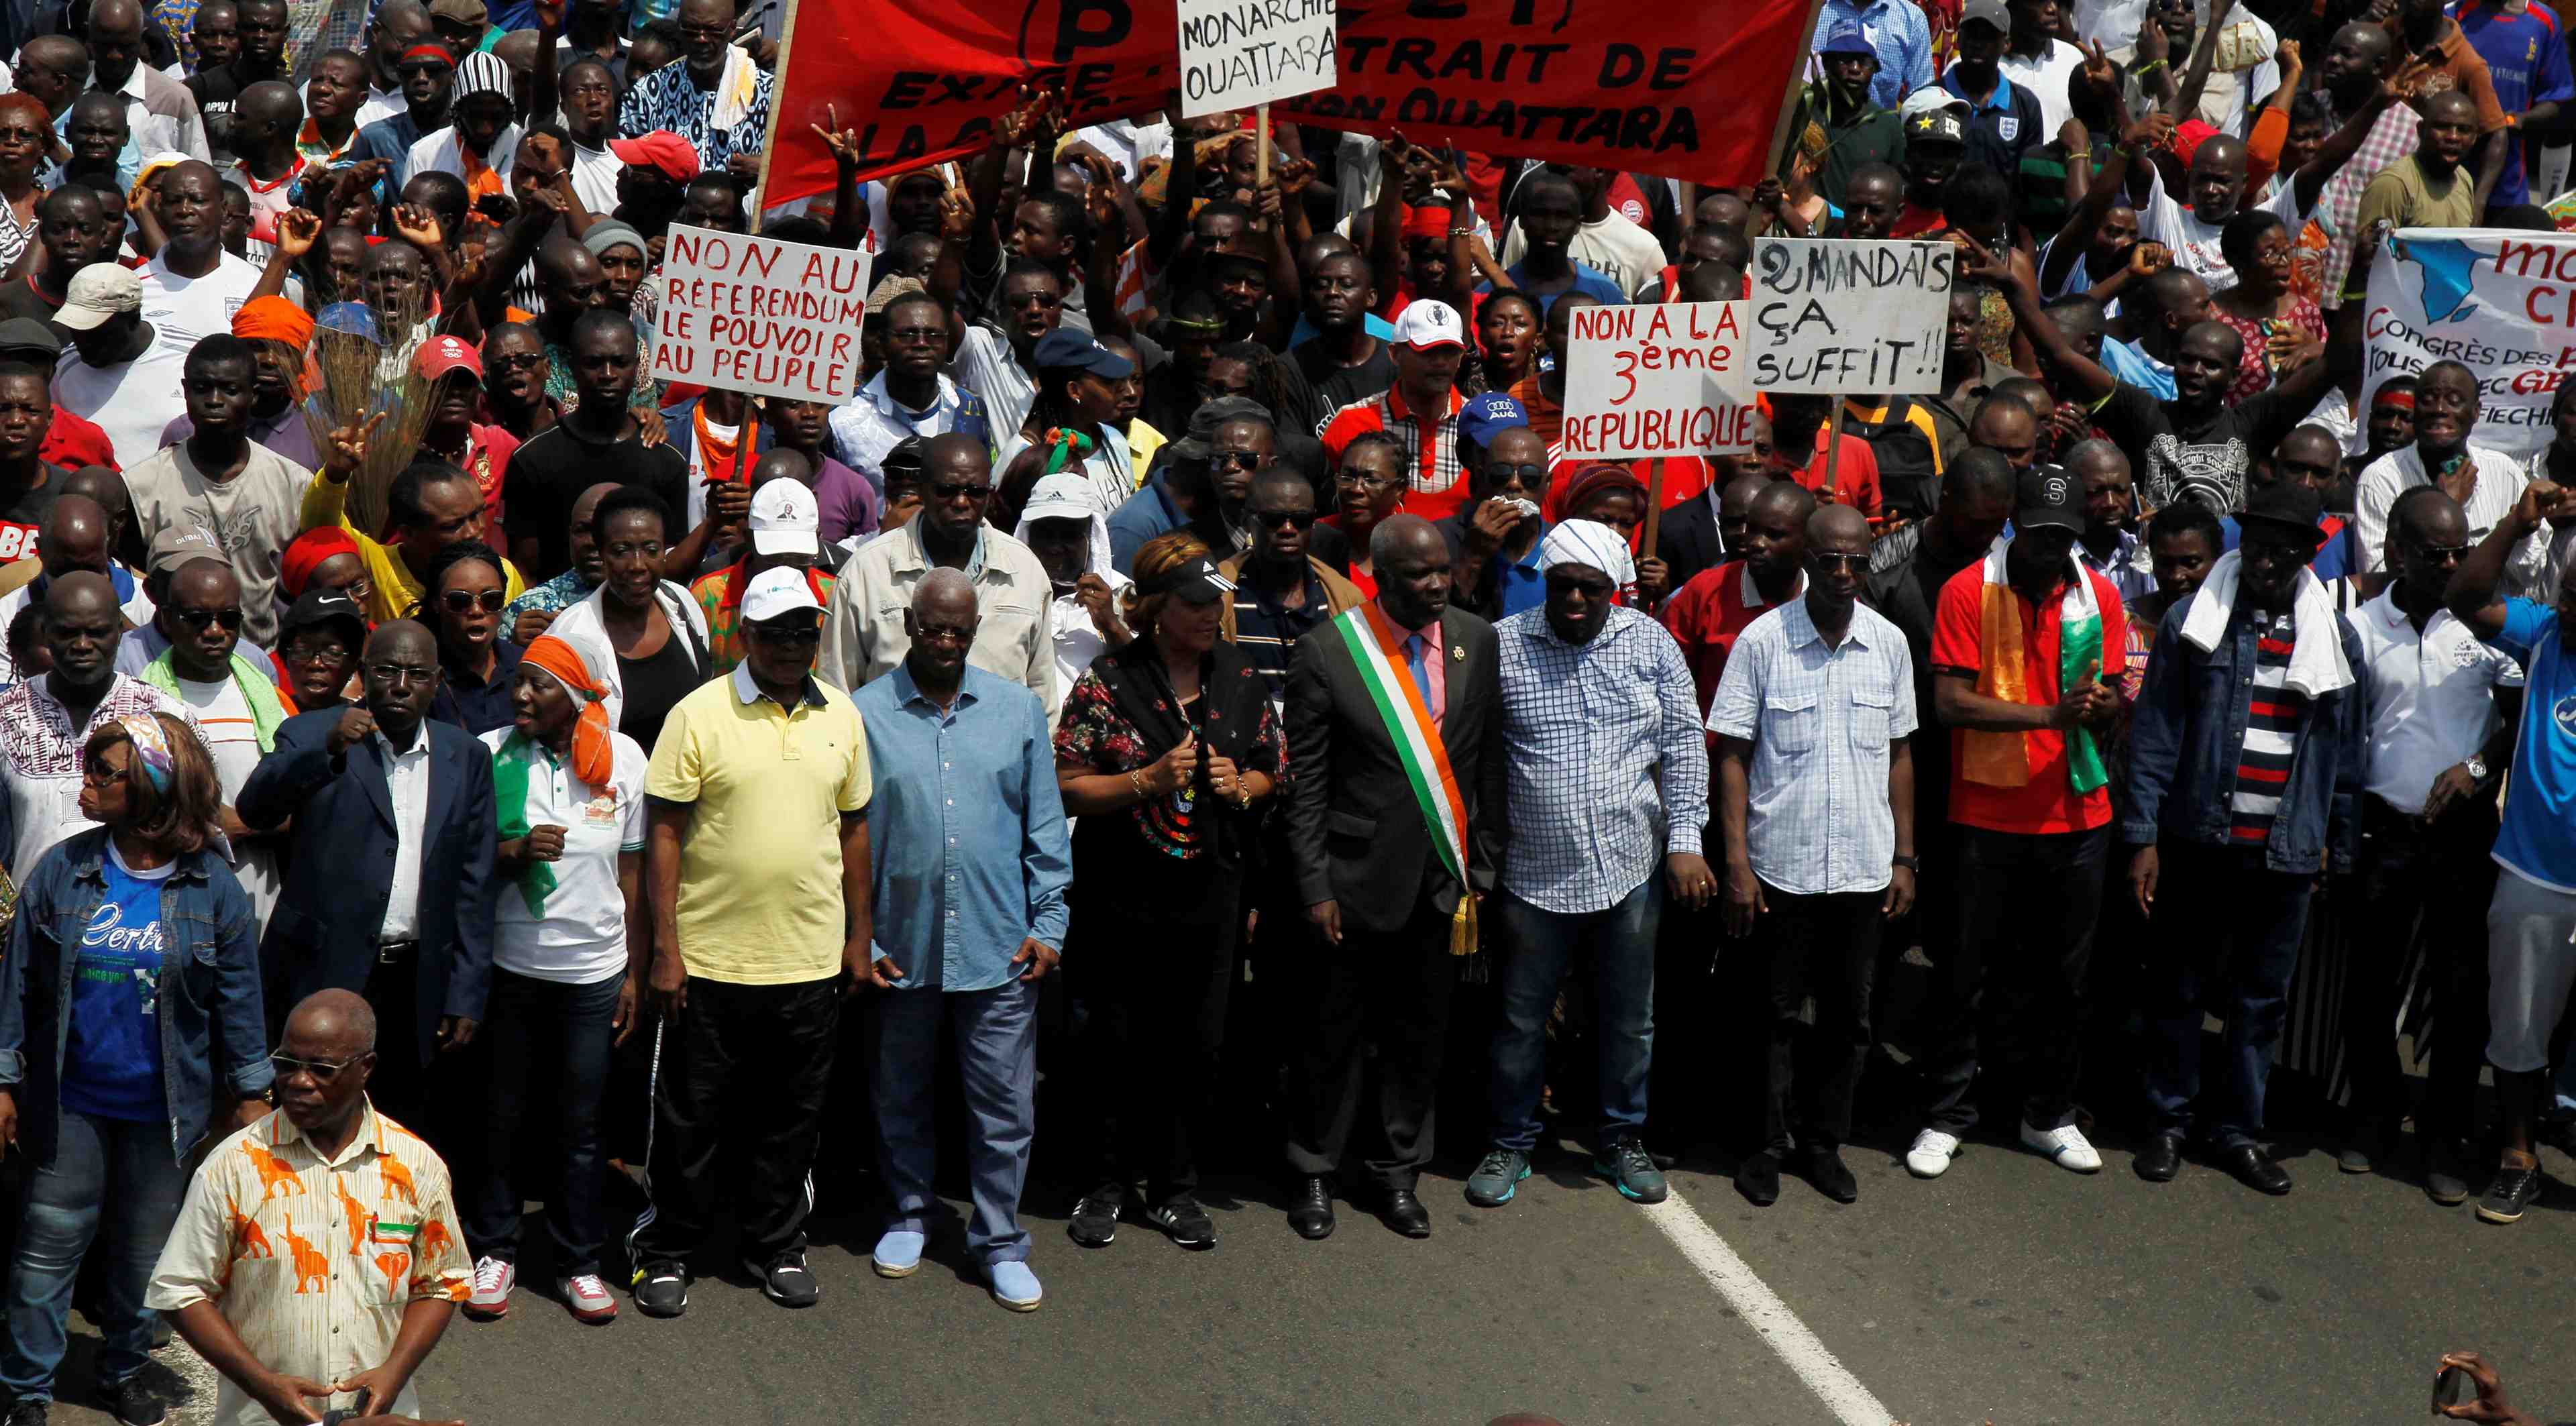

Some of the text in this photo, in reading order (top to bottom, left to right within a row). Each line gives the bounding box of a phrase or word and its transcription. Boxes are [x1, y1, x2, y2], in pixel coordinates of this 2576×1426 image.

[1187, 26, 1336, 100] OUATTARA
[1597, 44, 1697, 91] DE
[204, 101, 228, 113] new
[1398, 87, 1699, 152] OUATTARA
[672, 233, 859, 294] NON AU
[1760, 242, 1953, 294] 2 MANDATS
[662, 310, 853, 363] LE POUVOIR
[1574, 301, 1739, 341] NON A LA
[1757, 297, 1838, 346] ÇA
[654, 343, 845, 396] AU PEUPLE
[2502, 348, 2553, 366] DES
[1564, 404, 1755, 453] REPUBLIQUE
[175, 534, 202, 545] DUBAI
